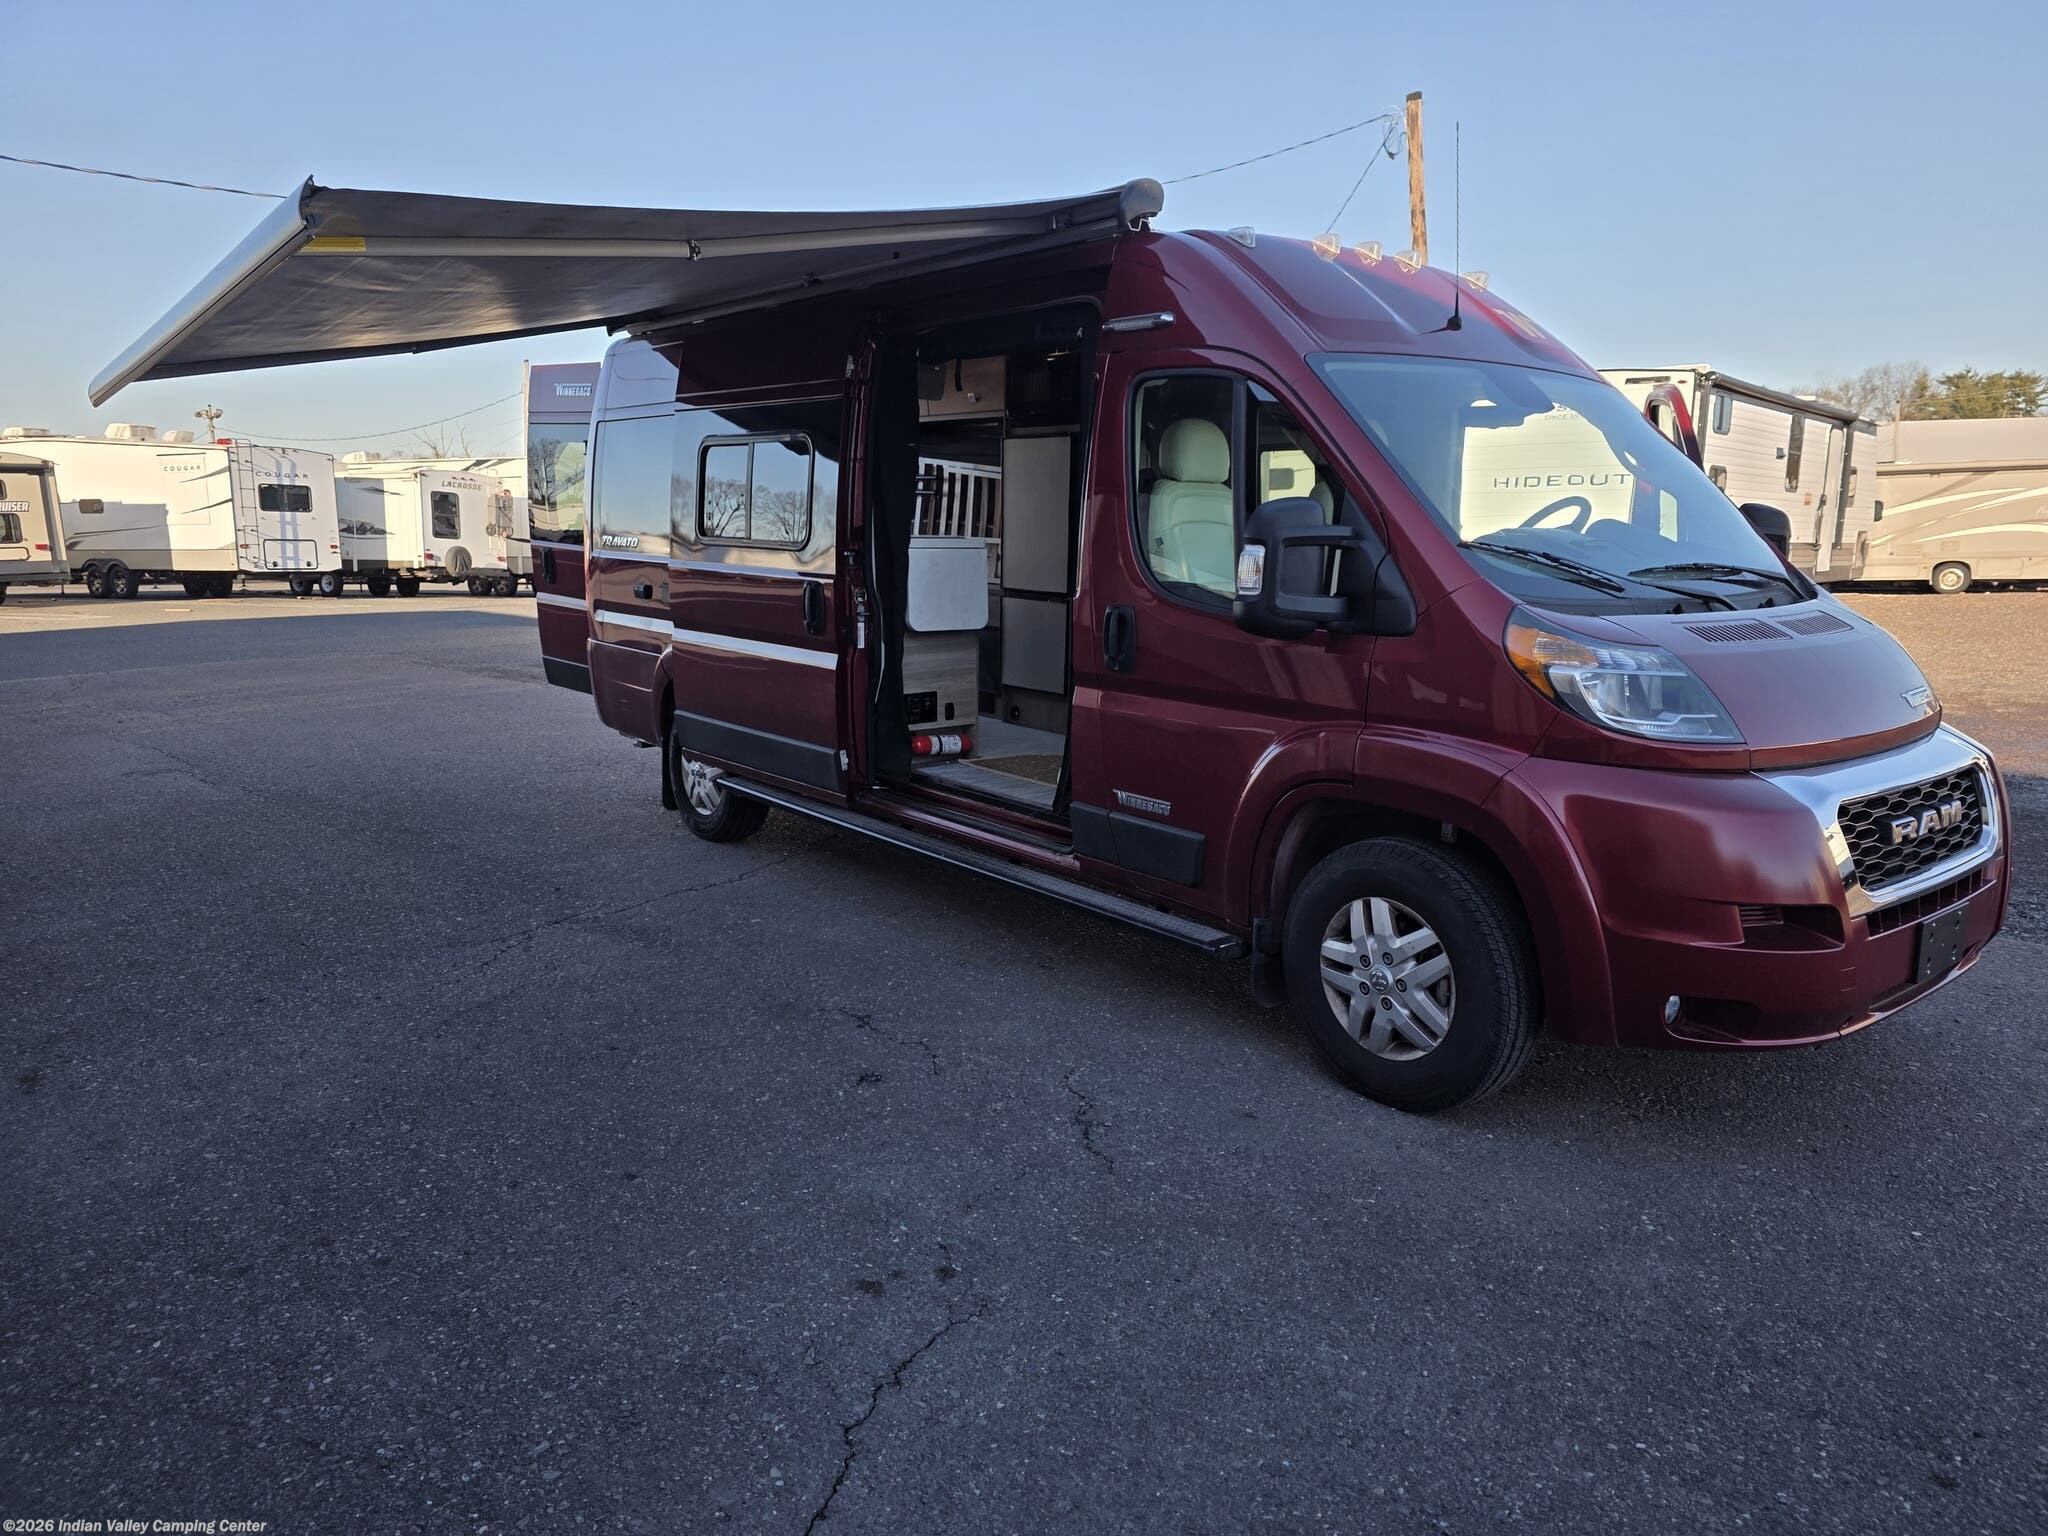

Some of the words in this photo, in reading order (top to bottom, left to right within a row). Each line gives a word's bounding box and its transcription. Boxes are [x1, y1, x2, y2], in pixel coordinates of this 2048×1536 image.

[255, 471, 309, 479] COUGAR
[1493, 473, 1631, 488] HIDEOUT
[441, 480, 483, 491] LACROSSE
[602, 534, 640, 547] TRAVATO
[1891, 799, 1963, 845] RAM
